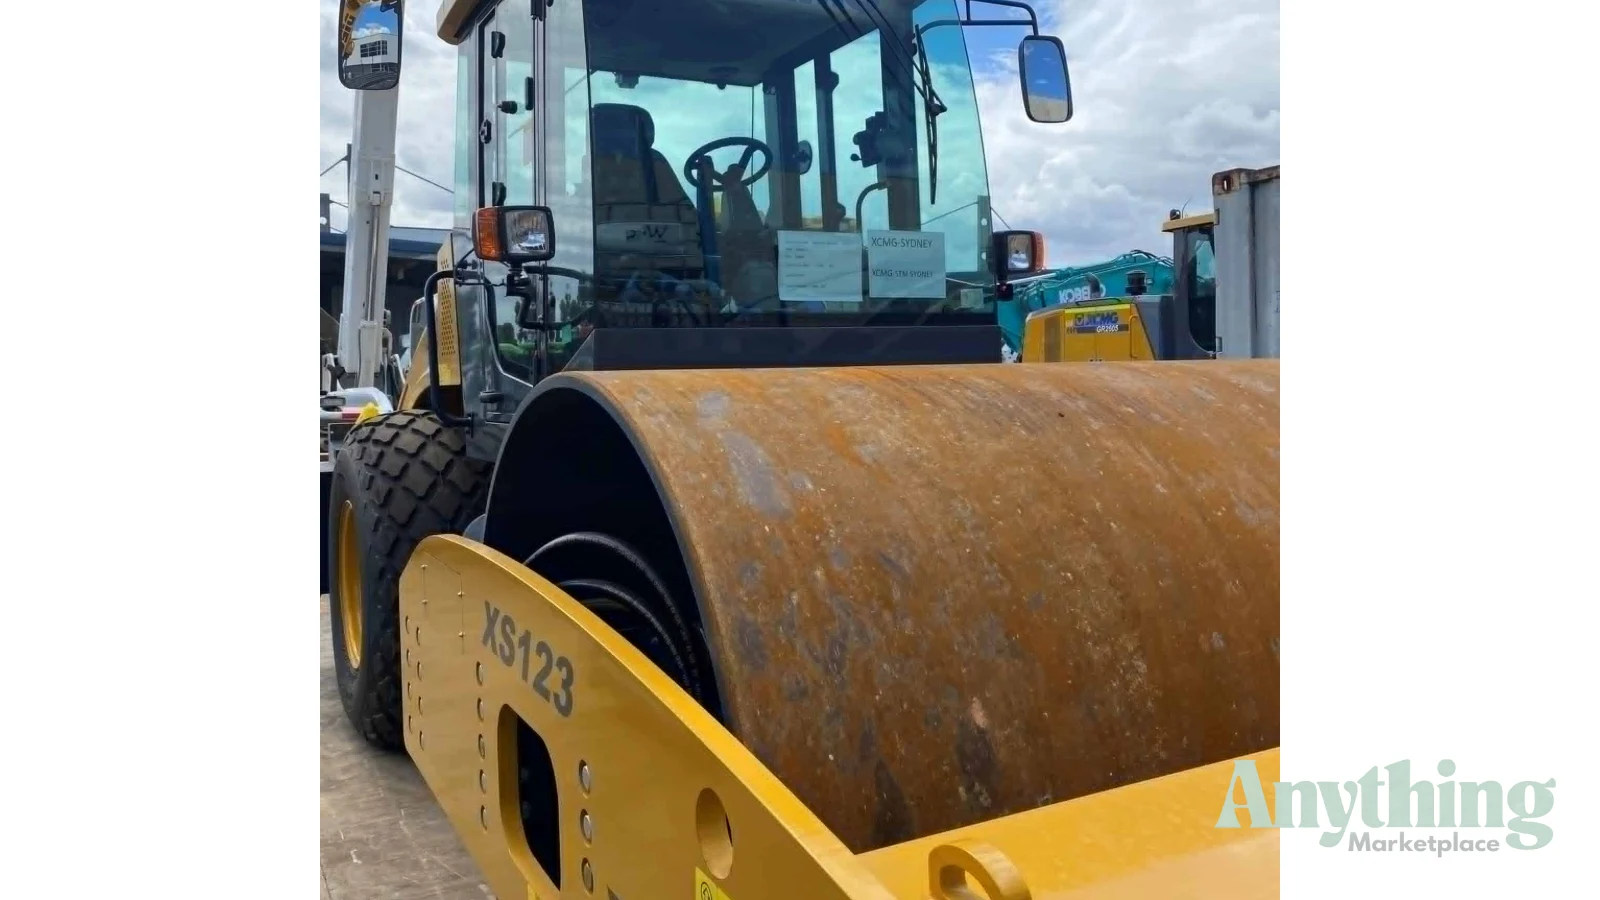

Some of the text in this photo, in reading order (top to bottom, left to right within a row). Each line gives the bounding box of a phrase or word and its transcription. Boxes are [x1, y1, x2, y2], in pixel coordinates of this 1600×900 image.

[871, 237, 933, 249] XCMG-SYDNEY
[1058, 283, 1106, 304] KOBELO
[482, 600, 574, 718] XS123
